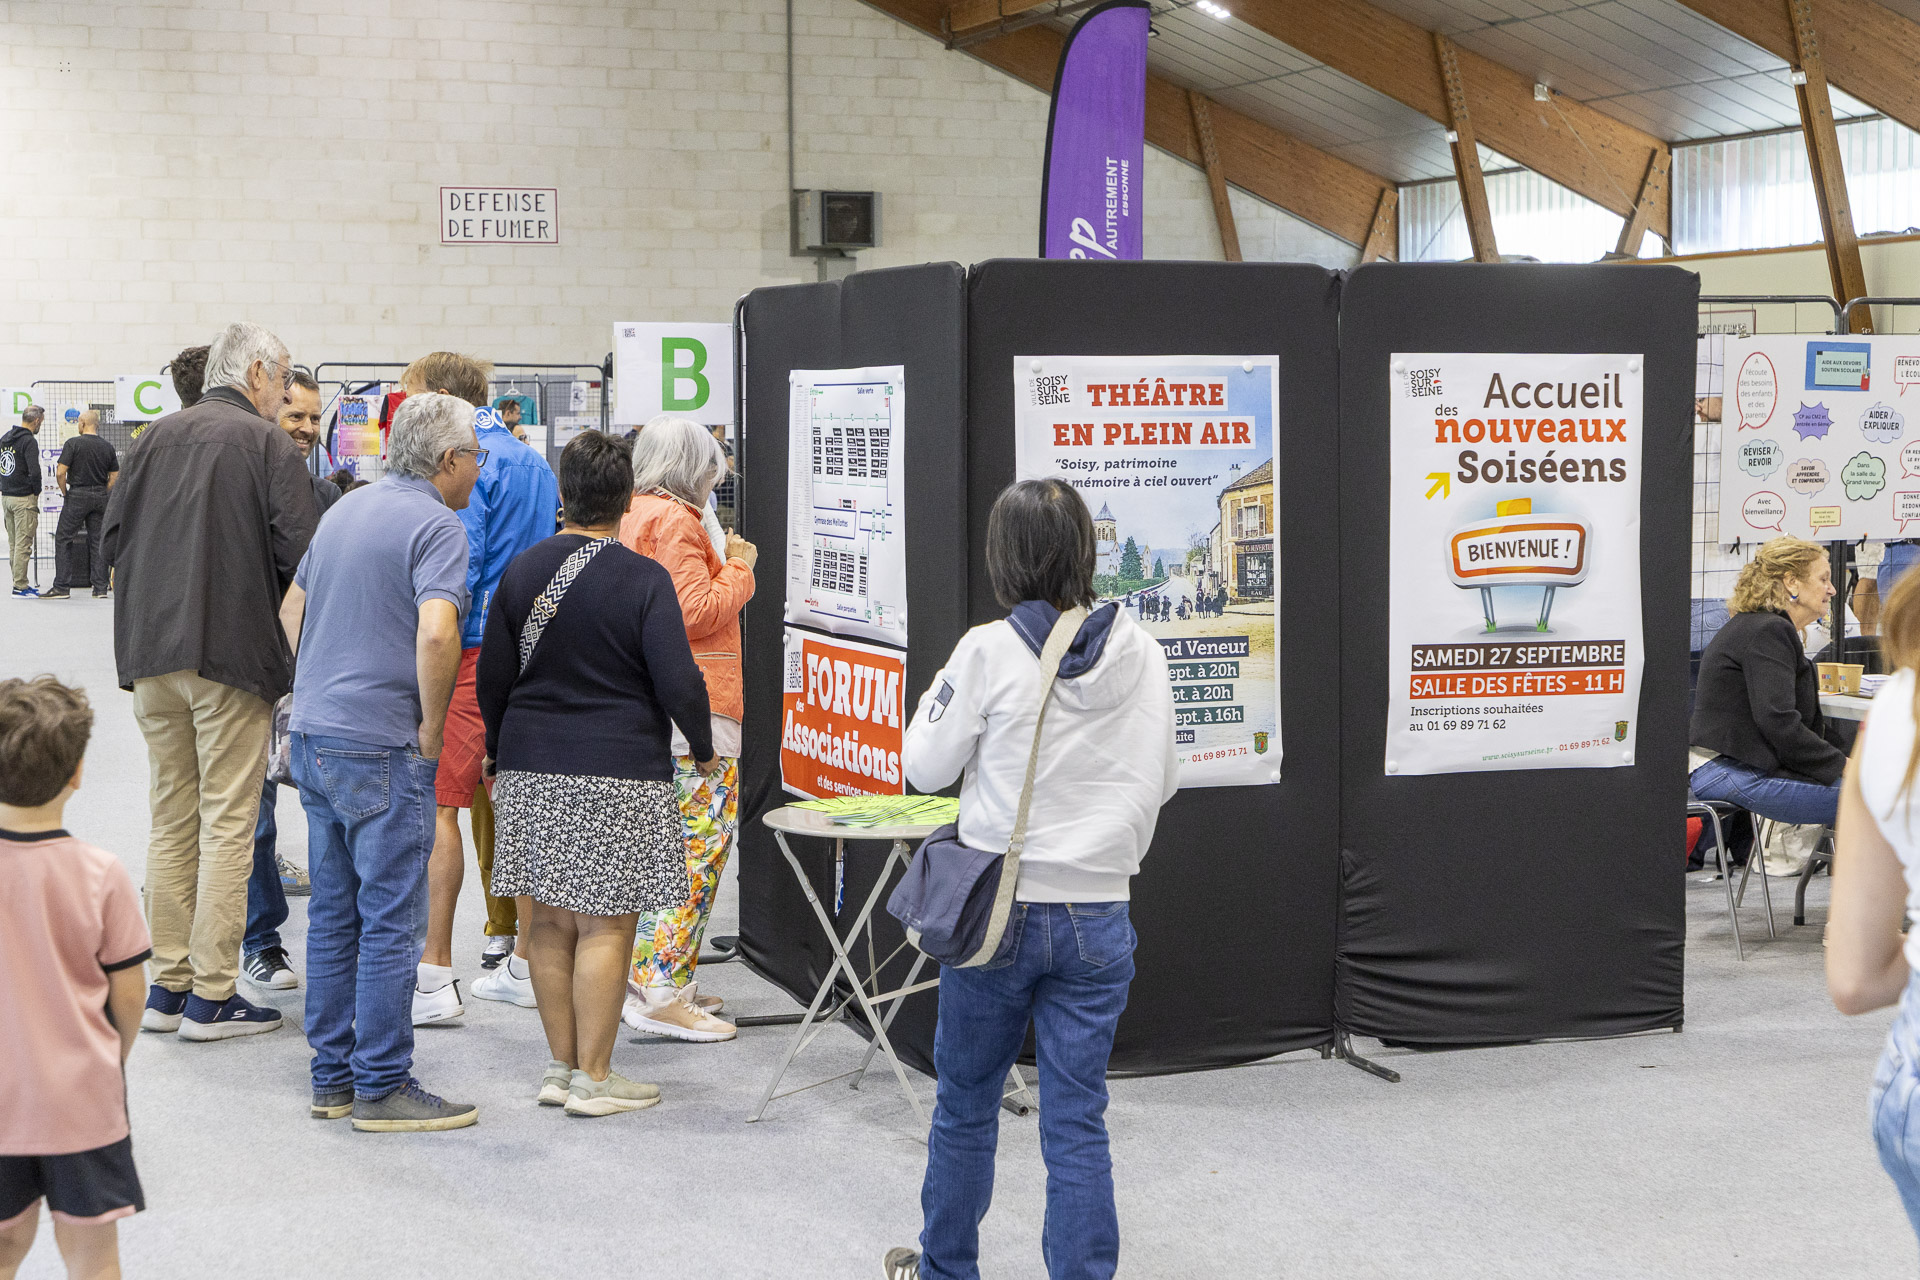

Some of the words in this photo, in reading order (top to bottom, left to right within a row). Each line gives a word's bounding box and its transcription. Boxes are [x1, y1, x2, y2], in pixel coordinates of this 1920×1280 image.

[1121, 159, 1129, 217] ESSONNE
[450, 192, 546, 212] DEFENSE
[1106, 156, 1118, 250] AUTREMENT
[449, 219, 474, 238] DE
[482, 219, 549, 238] FUMER
[662, 337, 710, 411] B
[1036, 375, 1068, 387] SOISY
[1410, 368, 1441, 380] SOISY
[1037, 386, 1059, 396] SUR
[1411, 378, 1432, 389] SUR
[1483, 372, 1623, 409] Accueil
[133, 380, 163, 415] C
[1038, 394, 1071, 405] SEINE
[1087, 377, 1224, 407] THÉÂTRE
[1412, 386, 1443, 398] SEINE
[13, 391, 33, 414] D
[1434, 404, 1458, 416] des
[1745, 412, 1767, 420] parents
[1868, 410, 1889, 419] AIDER
[1434, 418, 1627, 443] nouveaux
[1863, 421, 1900, 430] EXPLIQUER
[1053, 423, 1094, 446] EN
[1103, 423, 1193, 445] PLEIN
[1200, 422, 1251, 444] AIR
[1743, 446, 1772, 456] REVISER
[1104, 458, 1177, 471] patrimoine
[1457, 450, 1627, 484] Soiséens
[1748, 457, 1772, 467] REVOIR
[1071, 477, 1130, 488] mémoire
[1133, 476, 1141, 487] à
[1144, 476, 1167, 486] ciel
[1467, 538, 1559, 562] BIENVENUE
[1185, 640, 1248, 656] Veneur
[1413, 648, 1485, 667] SAMEDI
[1489, 647, 1512, 665] 27
[1516, 645, 1624, 665] SEPTEMBRE
[1168, 666, 1194, 681] ept.
[1198, 665, 1206, 677] à
[1209, 663, 1237, 677] 20h
[807, 653, 900, 729] FORUM
[1411, 677, 1467, 696] SALLE
[1472, 676, 1508, 695] DES
[1512, 672, 1567, 693] FÊTES
[1585, 674, 1604, 692] 11
[1609, 673, 1622, 691] H
[1192, 688, 1200, 700] à
[1203, 686, 1231, 700] 20h
[795, 698, 804, 713] des
[1410, 705, 1480, 717] Inscriptions
[1483, 703, 1544, 715] souhaitées
[1176, 711, 1200, 726] ept.
[1204, 709, 1212, 722] à
[1216, 708, 1242, 721] 16h
[1409, 723, 1424, 731] au
[1427, 721, 1440, 731] 01
[1443, 720, 1457, 730] 69
[1460, 720, 1474, 730] 89
[1477, 719, 1490, 729] 71
[1492, 719, 1506, 729] 62
[783, 709, 900, 785] Associations
[1570, 742, 1579, 750] 69
[1581, 740, 1590, 748] 89
[1192, 754, 1202, 763] 01
[1203, 752, 1214, 761] 69
[1215, 750, 1226, 758] 89
[1227, 748, 1237, 757] 71
[1238, 747, 1248, 755] 71
[817, 774, 823, 788] et
[823, 775, 834, 792] des
